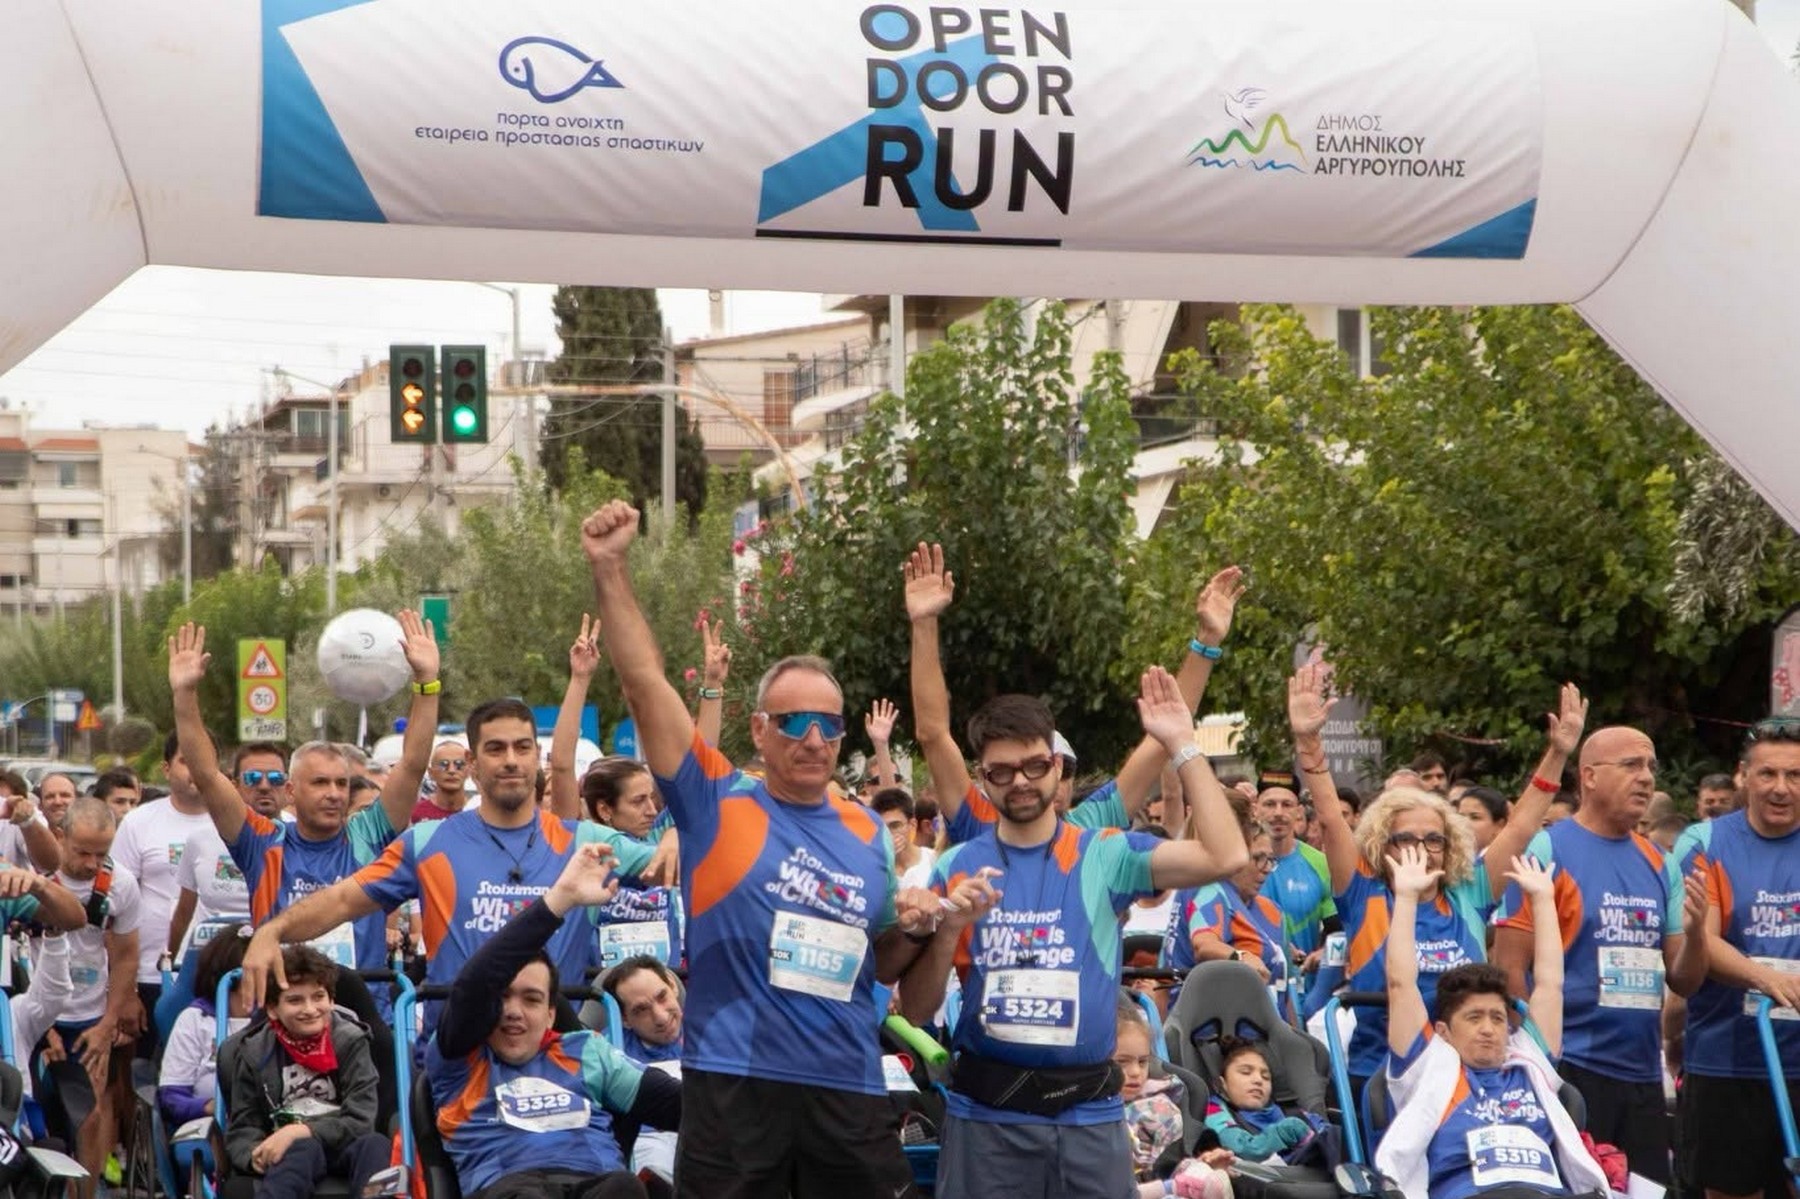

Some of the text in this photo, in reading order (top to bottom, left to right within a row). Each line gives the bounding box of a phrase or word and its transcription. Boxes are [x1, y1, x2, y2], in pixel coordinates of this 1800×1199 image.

[860, 4, 1072, 60] OPEN
[866, 58, 1075, 116] DOOR
[497, 113, 624, 131] πορτα ανοιχτη
[1316, 115, 1383, 132] ΔΗΜΟΣ
[415, 126, 705, 153] εταιρεια προστασιας σπαστικων
[1316, 135, 1426, 155] ΕΛΛΗΝΙΚΟΥ
[863, 124, 1075, 215] RUN
[1314, 157, 1467, 178] ΑΡΓΥΡΟΥΠΟΛΗΣ
[477, 881, 550, 896] Stoiximan
[1602, 891, 1658, 909] Stoiximan
[987, 907, 1063, 924] Stoiximan
[1755, 922, 1800, 938] Chan
[773, 950, 790, 961] 10K
[798, 946, 845, 973] 1165
[1623, 971, 1655, 988] 1136
[1004, 998, 1064, 1019] 5324
[516, 1093, 572, 1112] 5329
[1494, 1147, 1542, 1165] 5319
